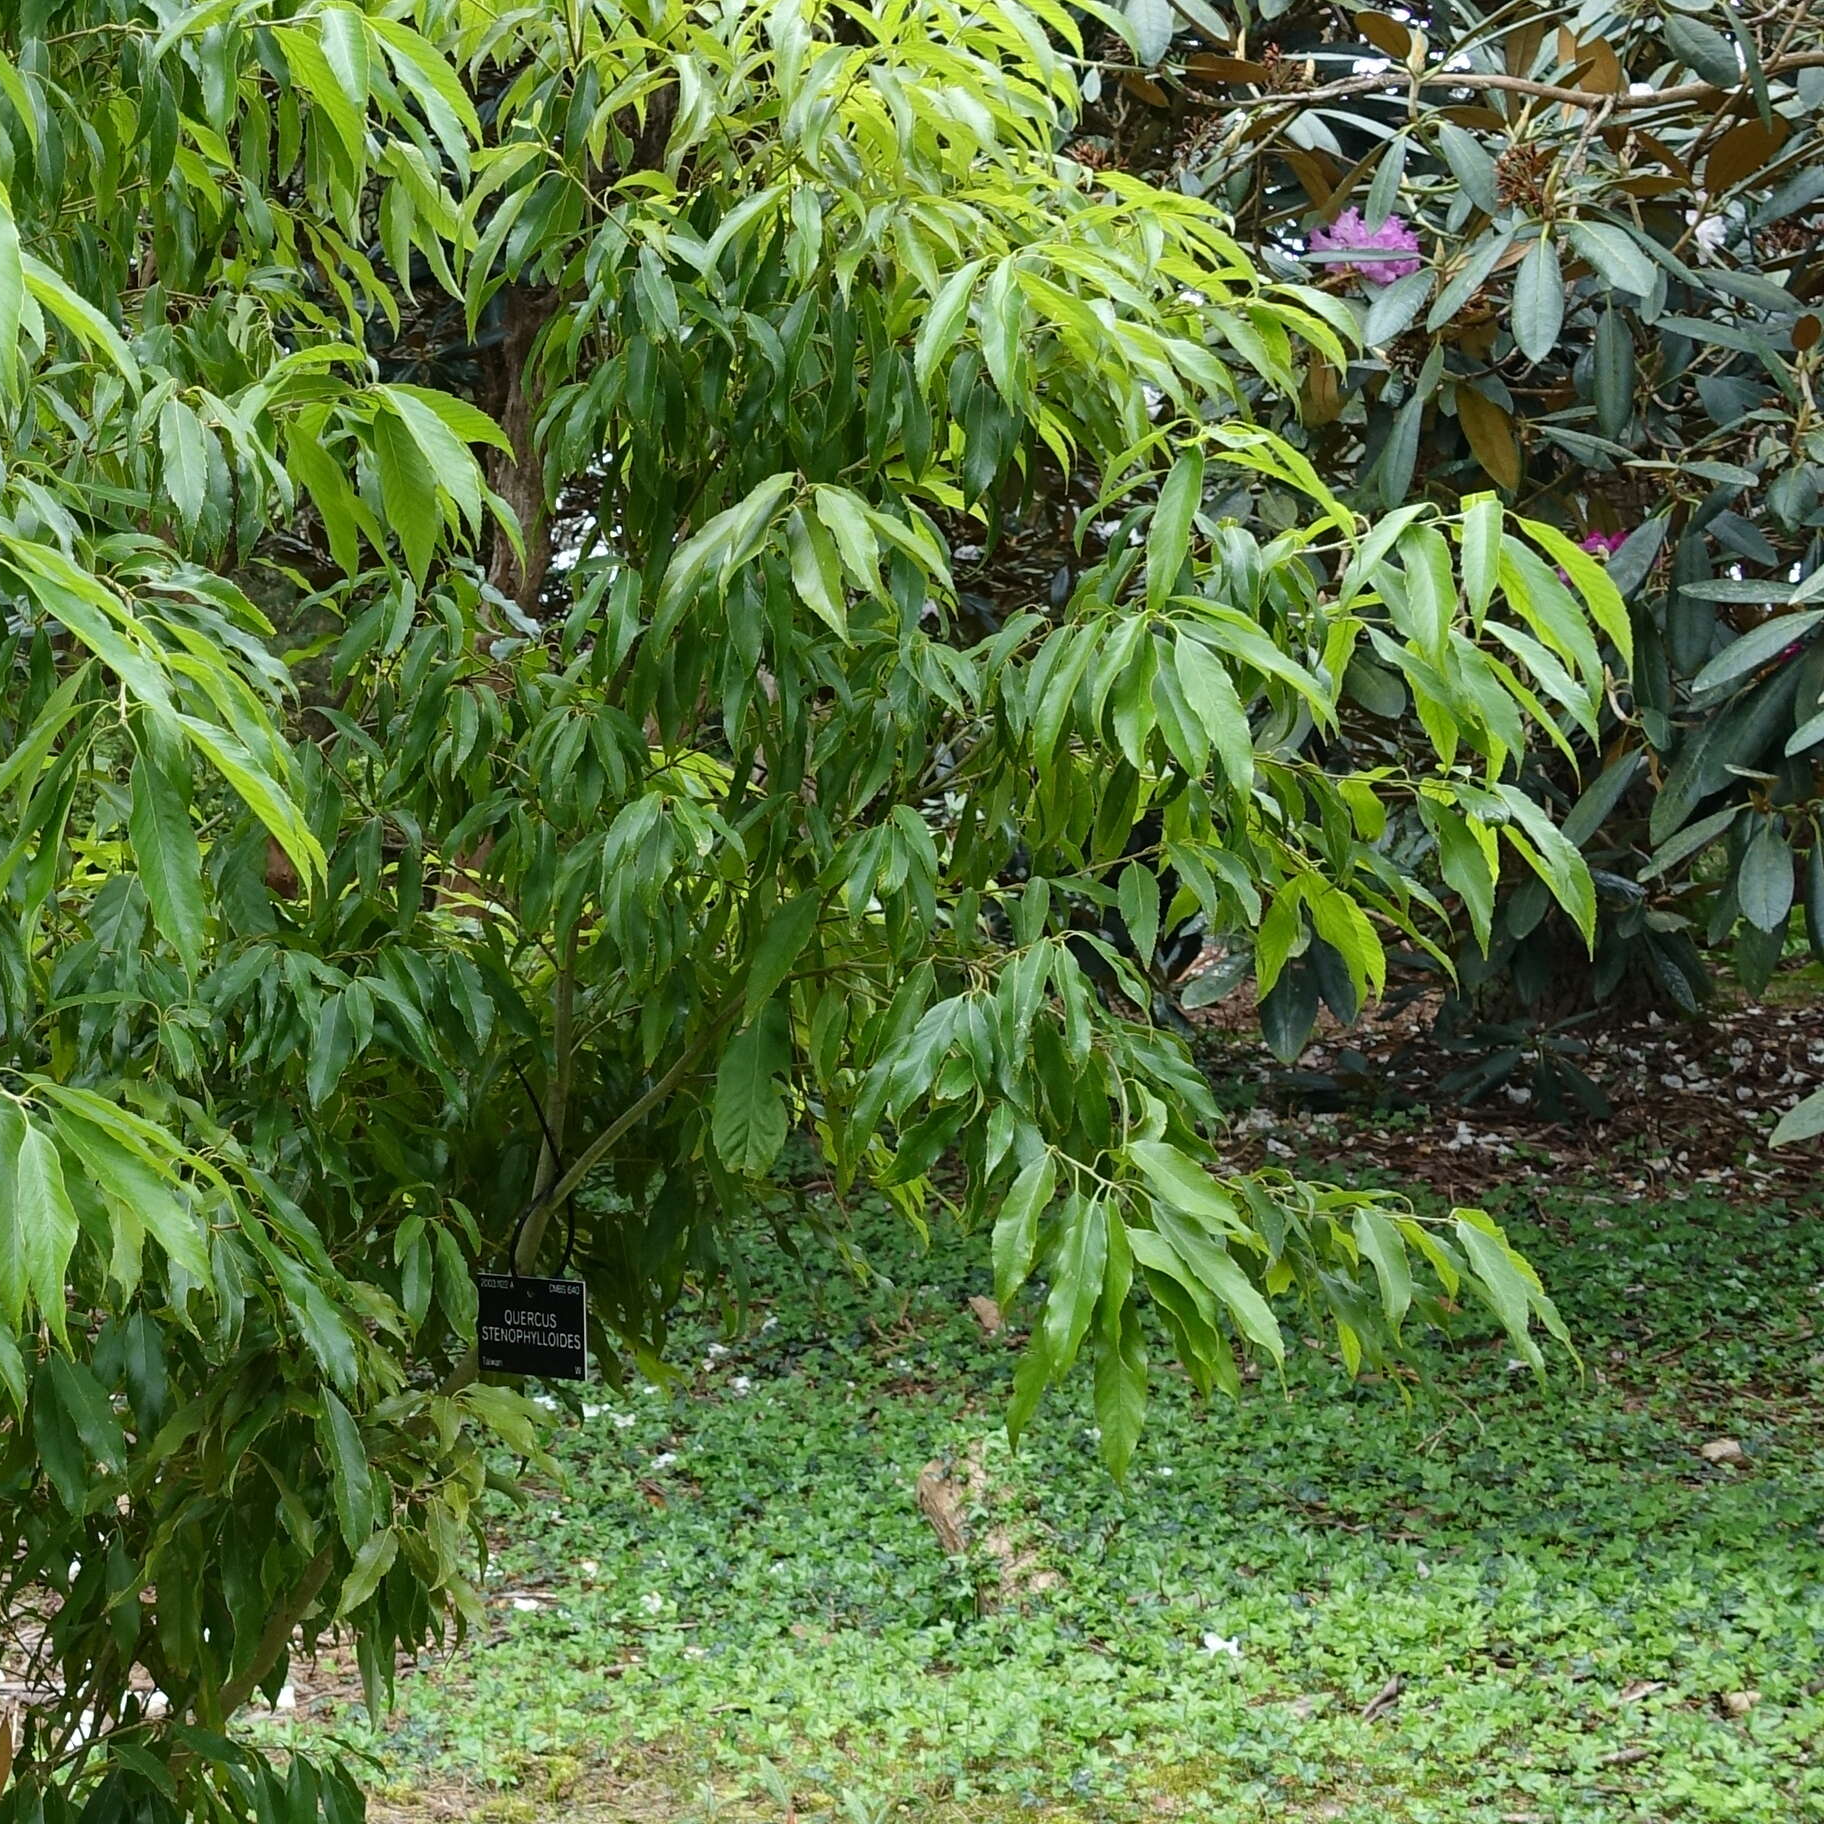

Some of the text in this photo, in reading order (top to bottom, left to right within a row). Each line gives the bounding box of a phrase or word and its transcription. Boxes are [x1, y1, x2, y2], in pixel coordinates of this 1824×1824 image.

[567, 1285, 580, 1296] 640
[504, 1309, 557, 1329] QUERCUS
[481, 1326, 582, 1350] STENOPHYLLOIDES
[482, 1356, 503, 1367] Taiwan
